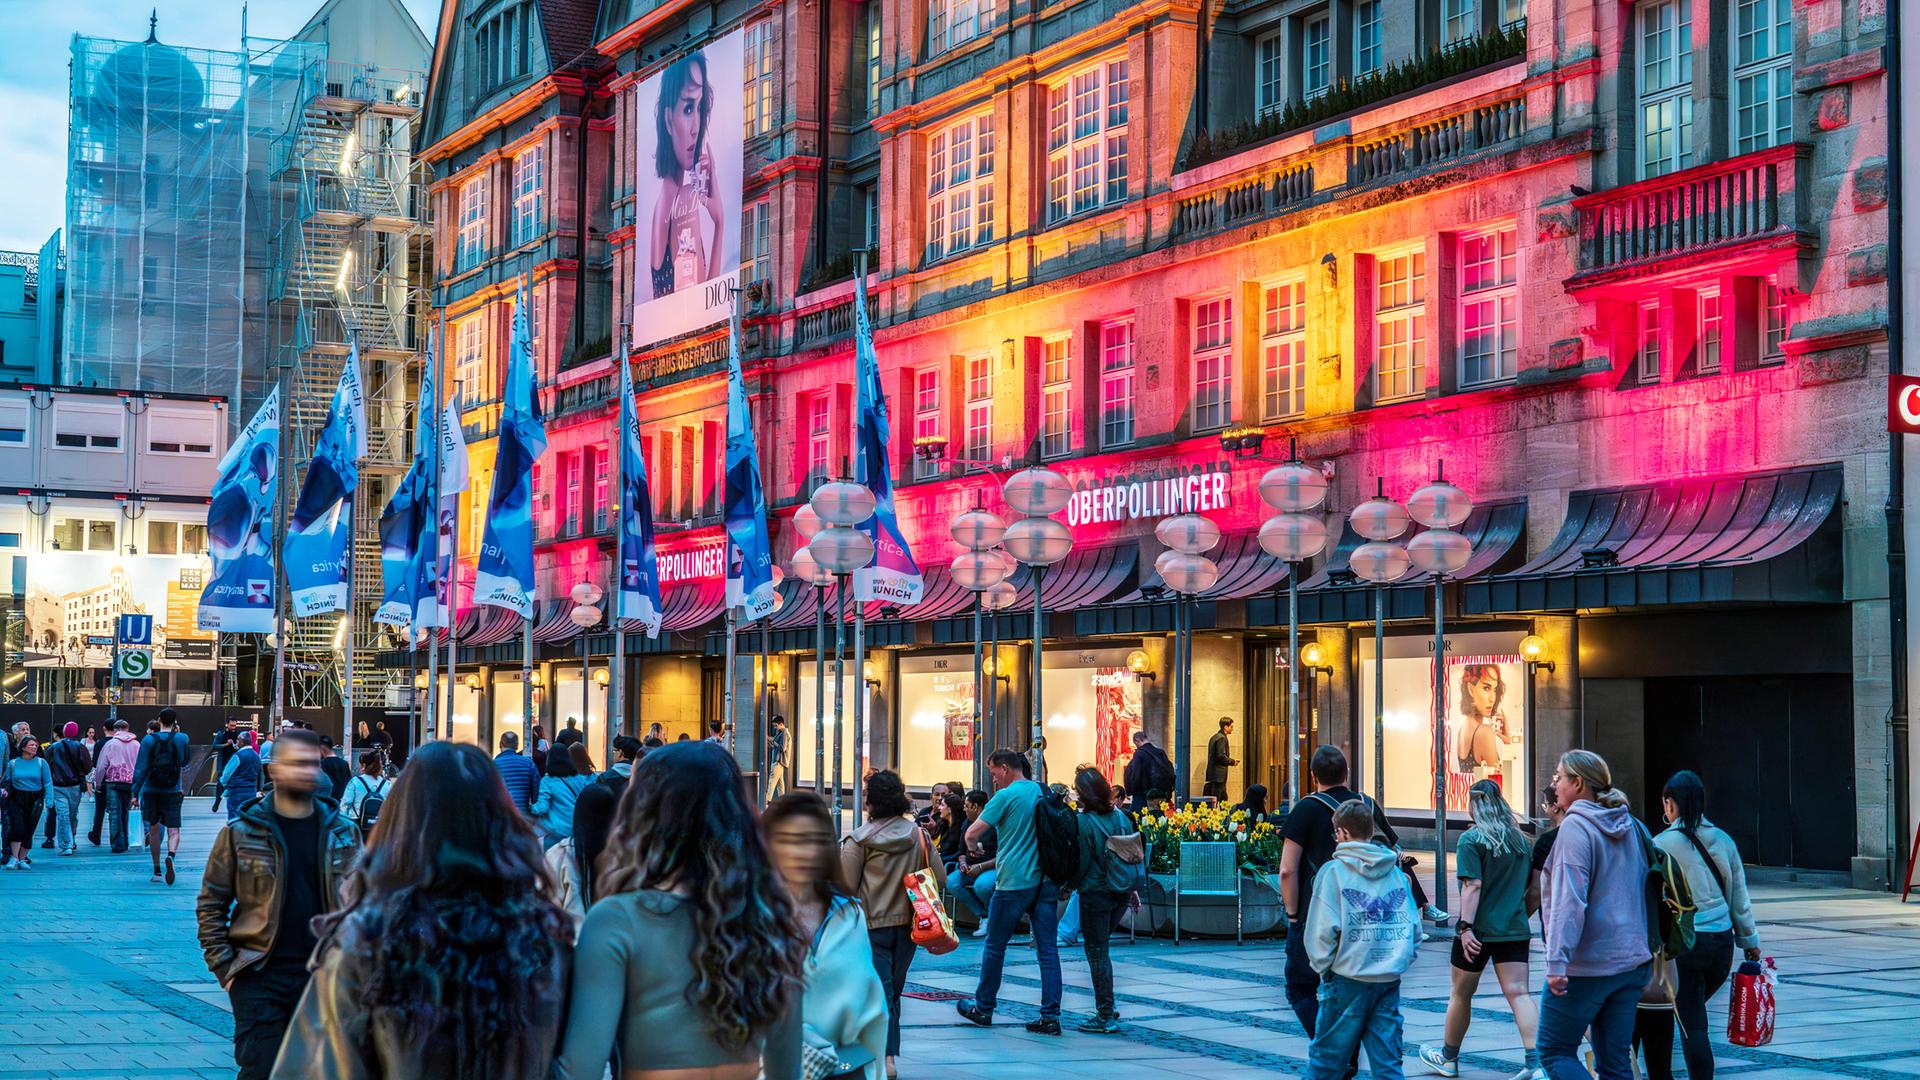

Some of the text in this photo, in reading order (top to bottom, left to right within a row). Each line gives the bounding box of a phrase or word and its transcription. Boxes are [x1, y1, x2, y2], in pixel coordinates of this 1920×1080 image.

[705, 277, 735, 310] DIOR
[1067, 472, 1226, 527] OBERPOLLINGER
[656, 548, 724, 582] ERPOLLINGER
[181, 582, 201, 590] MAX
[127, 616, 147, 643] U
[1428, 640, 1452, 652] DOR
[127, 653, 145, 674] S
